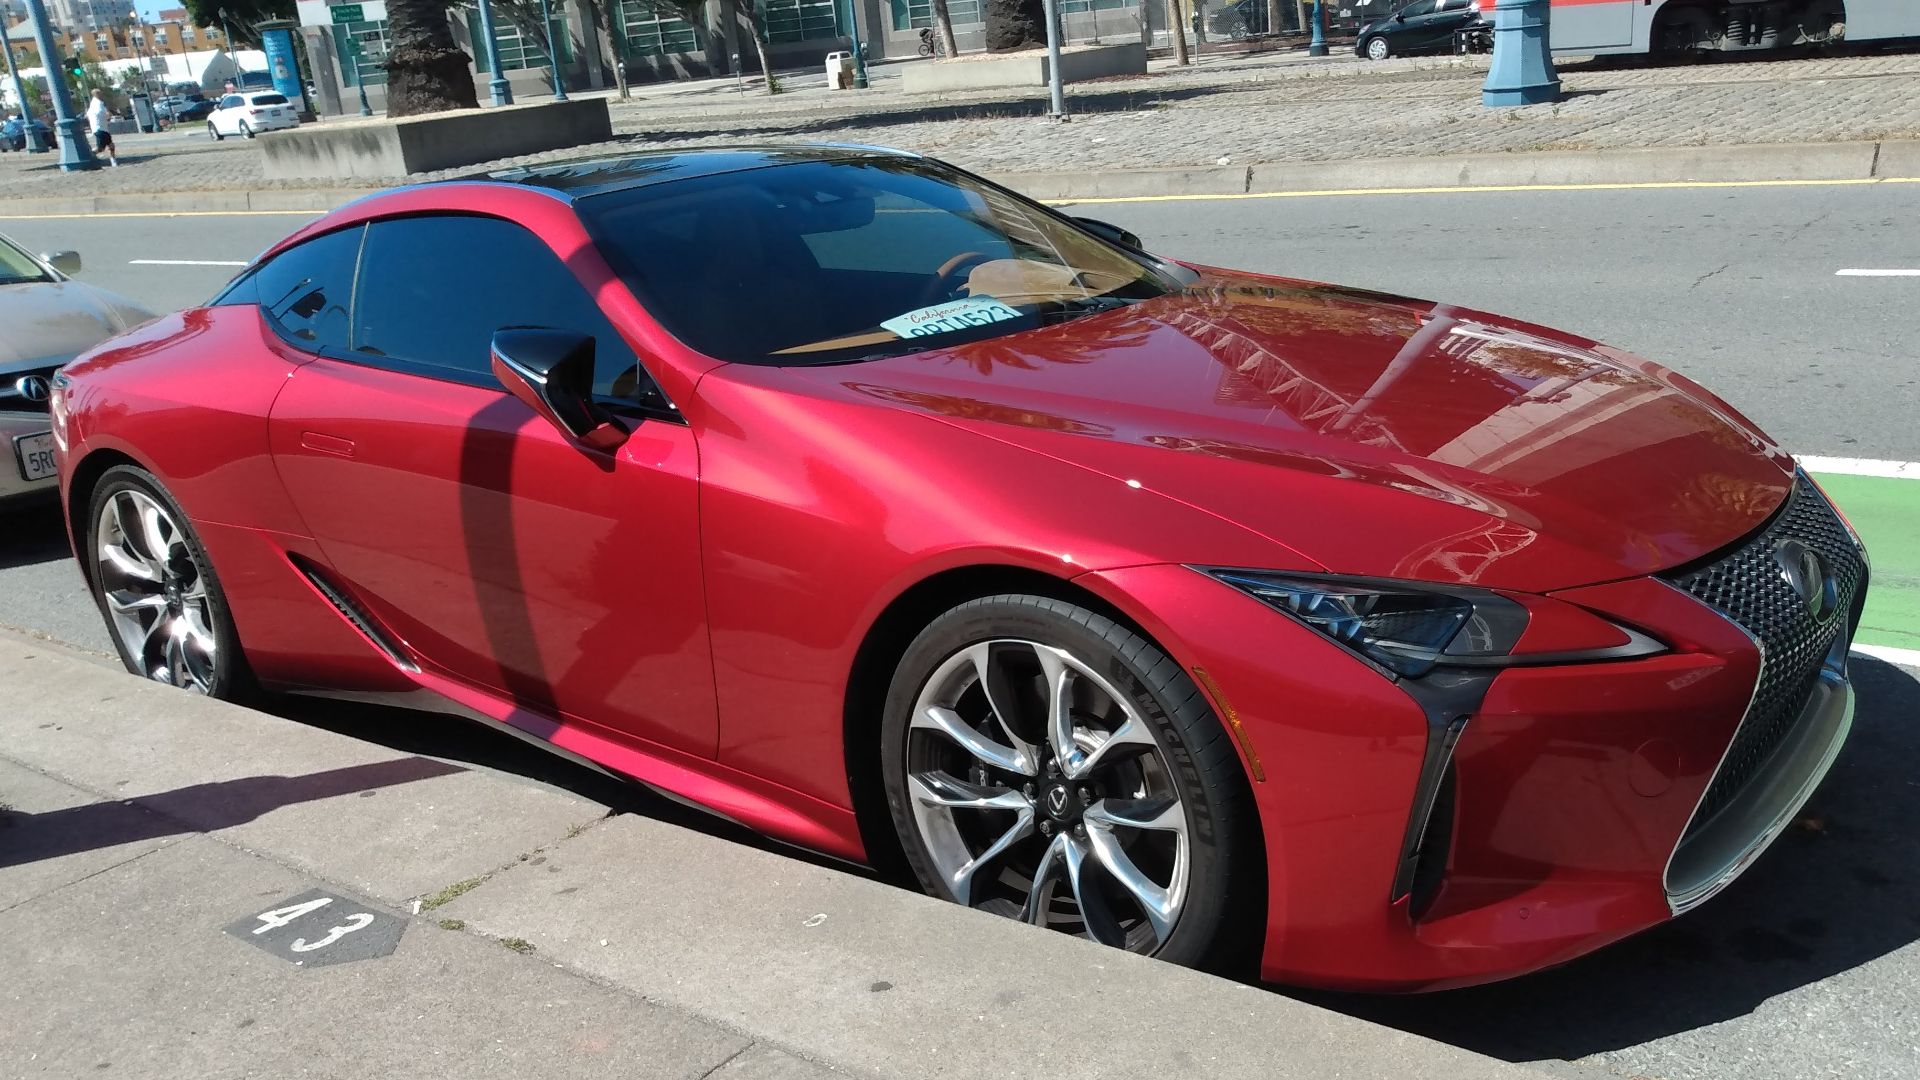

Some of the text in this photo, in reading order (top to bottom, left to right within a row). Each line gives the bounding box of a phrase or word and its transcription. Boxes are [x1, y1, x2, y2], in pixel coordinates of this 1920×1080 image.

[910, 304, 970, 324] California
[1135, 690, 1214, 843] MICHELIN
[252, 897, 374, 952] 43
